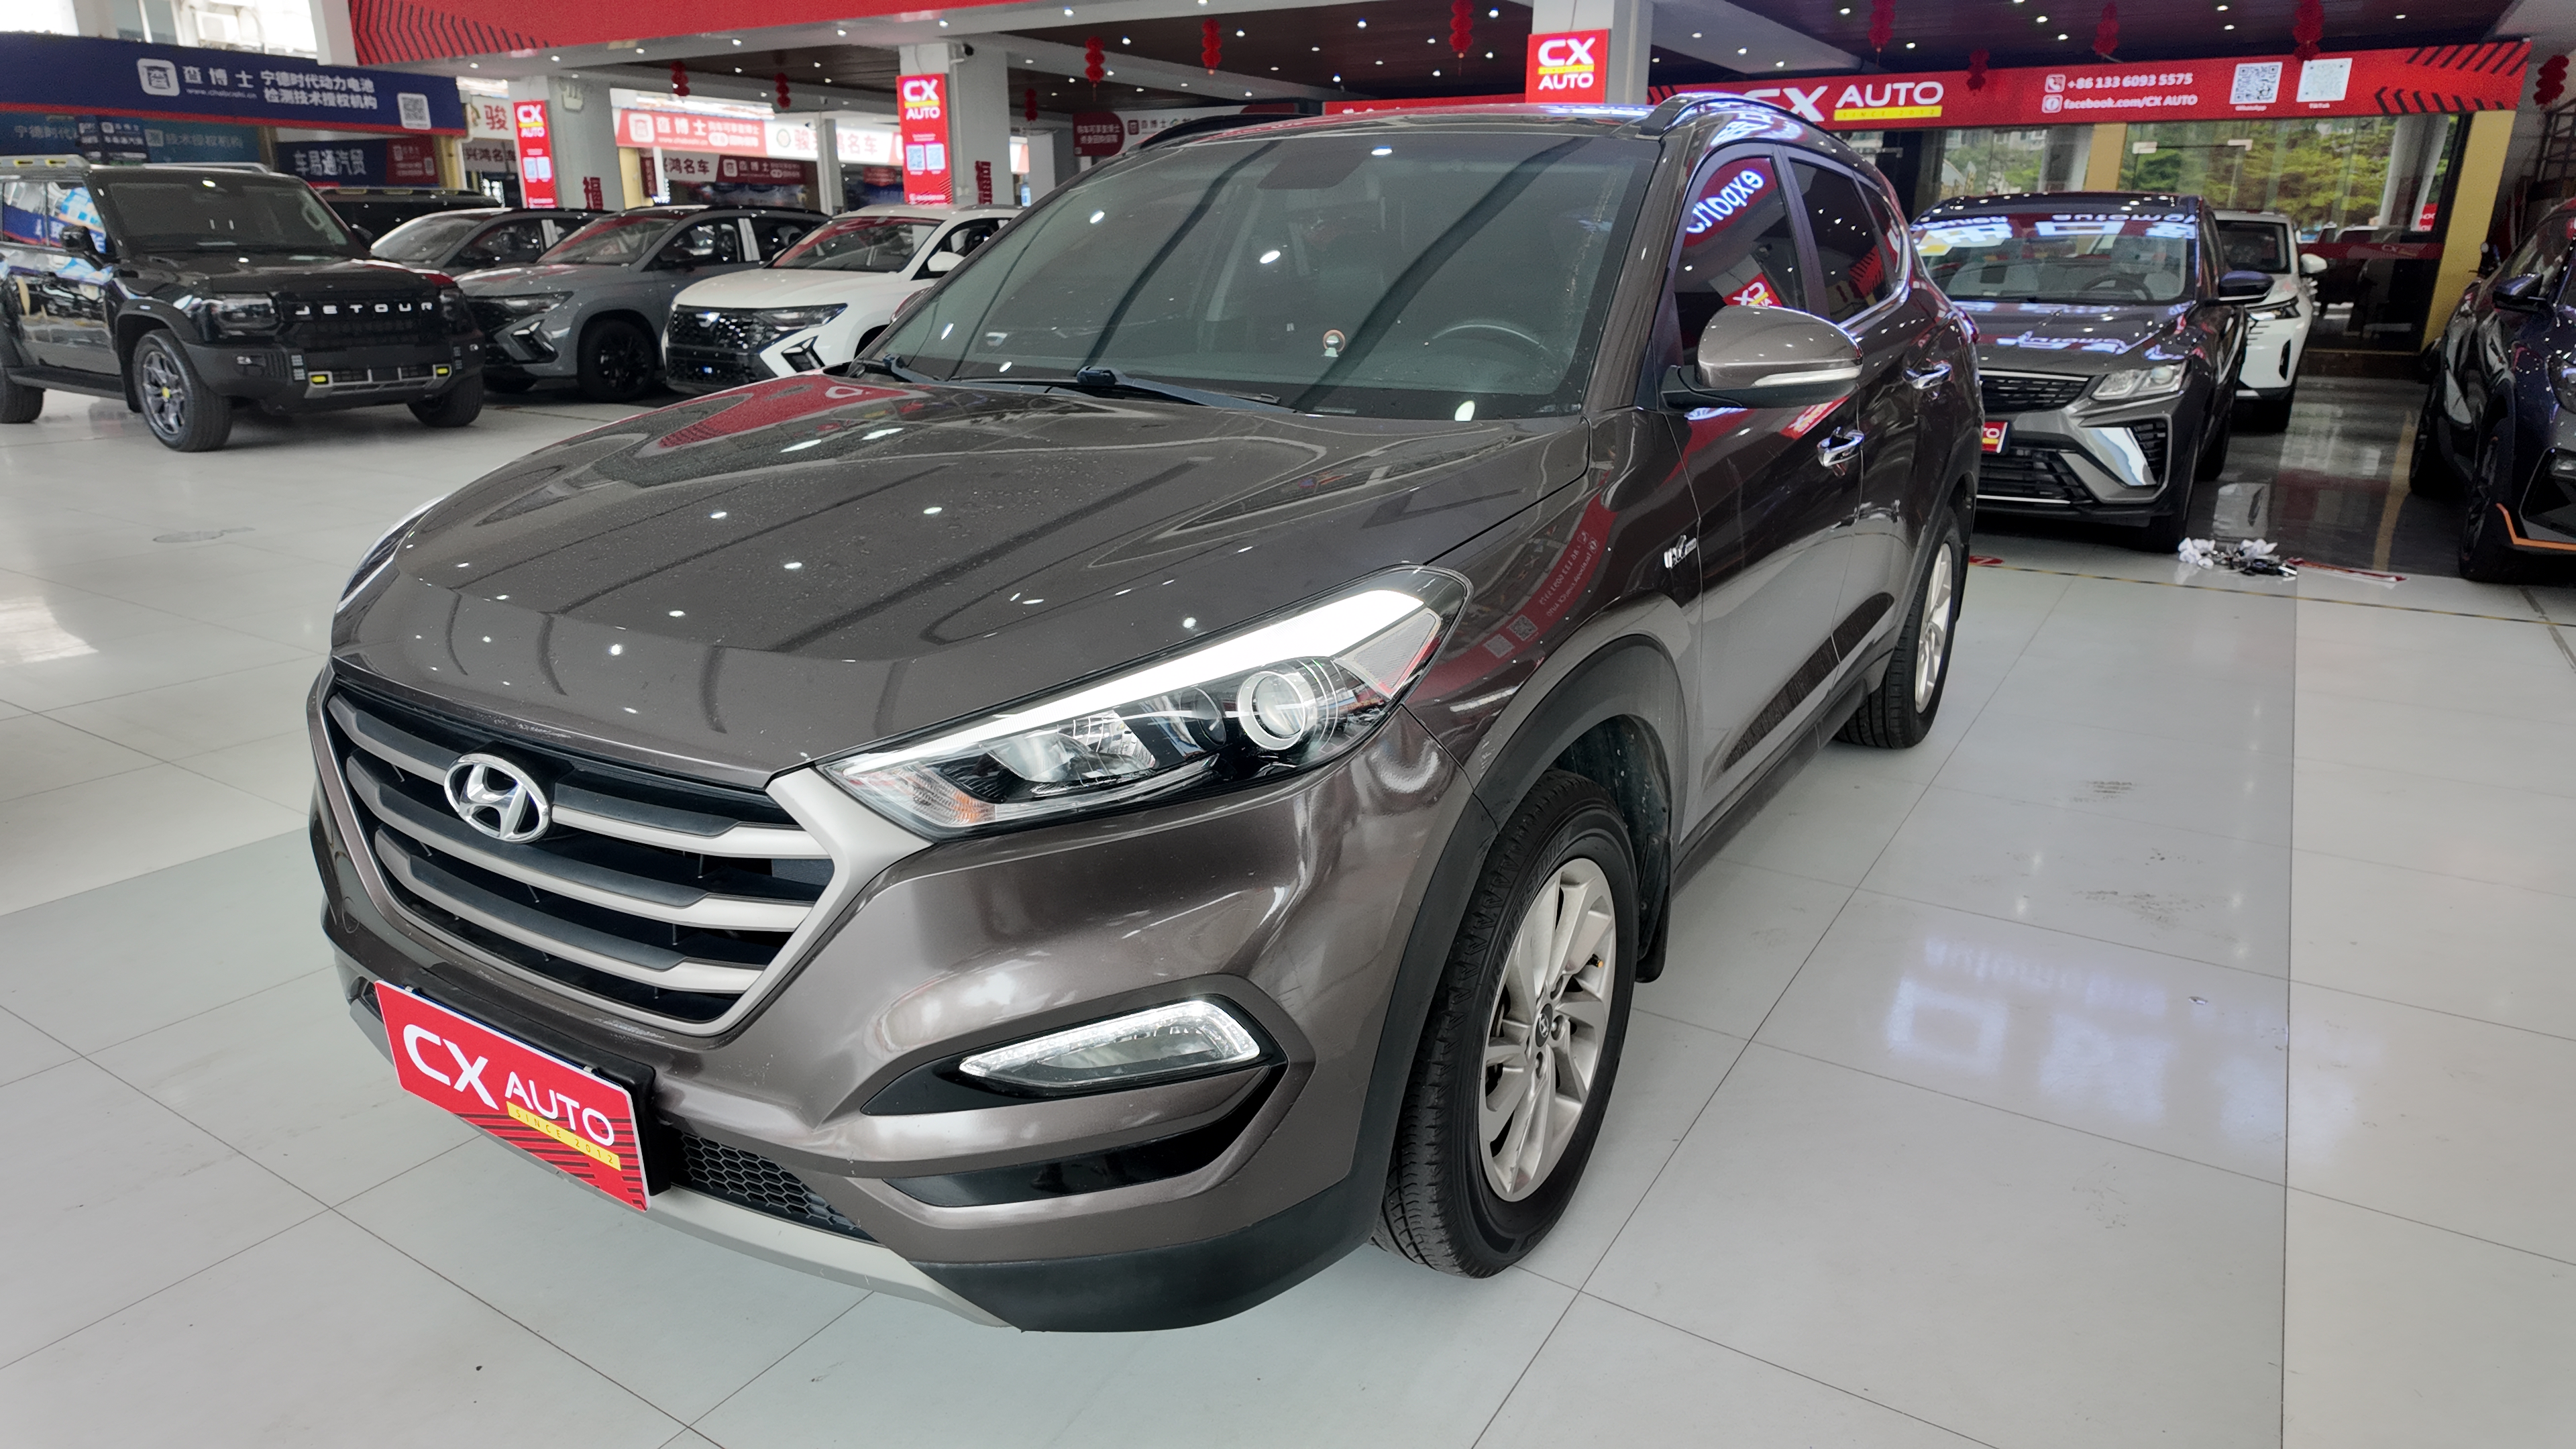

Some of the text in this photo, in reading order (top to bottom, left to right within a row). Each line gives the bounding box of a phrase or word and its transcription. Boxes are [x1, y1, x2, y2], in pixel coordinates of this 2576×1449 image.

[1538, 37, 1596, 66] CX
[182, 66, 254, 89] 查博士
[260, 69, 375, 93] 宁德时代动力电池
[1538, 72, 1594, 91] AUTO
[2095, 76, 2121, 89] 133
[2122, 74, 2157, 87] 6093
[2158, 72, 2194, 86] 5575
[263, 87, 378, 110] 检测技术授权机构
[903, 78, 938, 102] CX
[1835, 80, 1944, 108] AUTO
[2163, 94, 2198, 106] AUTO
[517, 104, 543, 122] CX
[906, 107, 941, 121] AUTO
[521, 126, 545, 138] AUTO
[295, 301, 433, 315] JETOUR
[403, 1024, 615, 1146] CX AUTO
[515, 1108, 615, 1165] SINCE 2012
